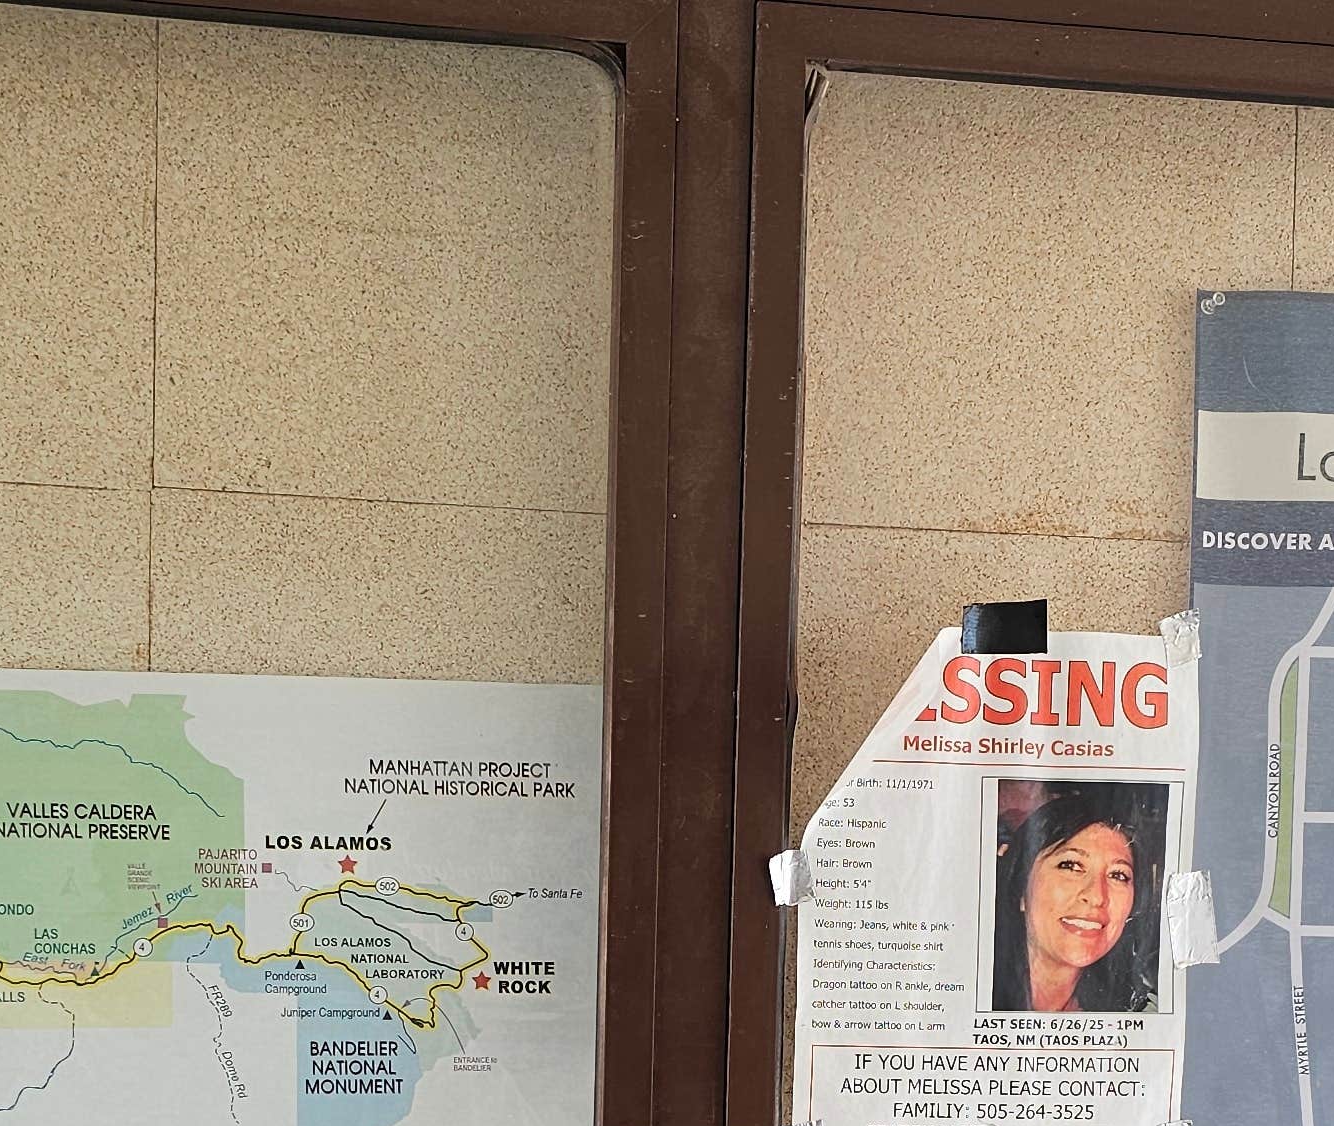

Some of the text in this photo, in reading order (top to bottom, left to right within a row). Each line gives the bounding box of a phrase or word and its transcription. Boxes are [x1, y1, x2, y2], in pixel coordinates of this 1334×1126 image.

[1203, 531, 1312, 550] DISCOVER
[904, 736, 1113, 759] Melissa Shirley Casias
[369, 759, 550, 782] MANHATTAN PROJECT
[345, 778, 575, 798] NATIONAL HISTORICAL PARK
[7, 803, 156, 820] VALLES CALDERA
[89, 824, 170, 840] PRESERVE
[819, 819, 886, 830] Race: Hispanic
[266, 836, 391, 851] LOS ALAMOS
[377, 882, 398, 892] 502
[494, 961, 554, 976] WHITE
[499, 980, 551, 994] ROCK
[281, 1007, 380, 1020] Juniper Campground
[974, 1019, 1006, 1029] LAST
[1010, 1019, 1045, 1029] SEEN:
[1051, 1019, 1103, 1031] 6/26/25
[1117, 1020, 1143, 1030] 1PM
[311, 1039, 398, 1056] BANDELIER
[313, 1060, 396, 1075] NATIONAL
[855, 1054, 1139, 1072] IF YOU HAVE ANY INFORMATION
[306, 1079, 403, 1094] MONUMENT
[841, 1078, 1145, 1097] ABOUT MELISSA PLEASE CONTACT:
[894, 1103, 1093, 1119] FAMILIY: 505-264-3525
